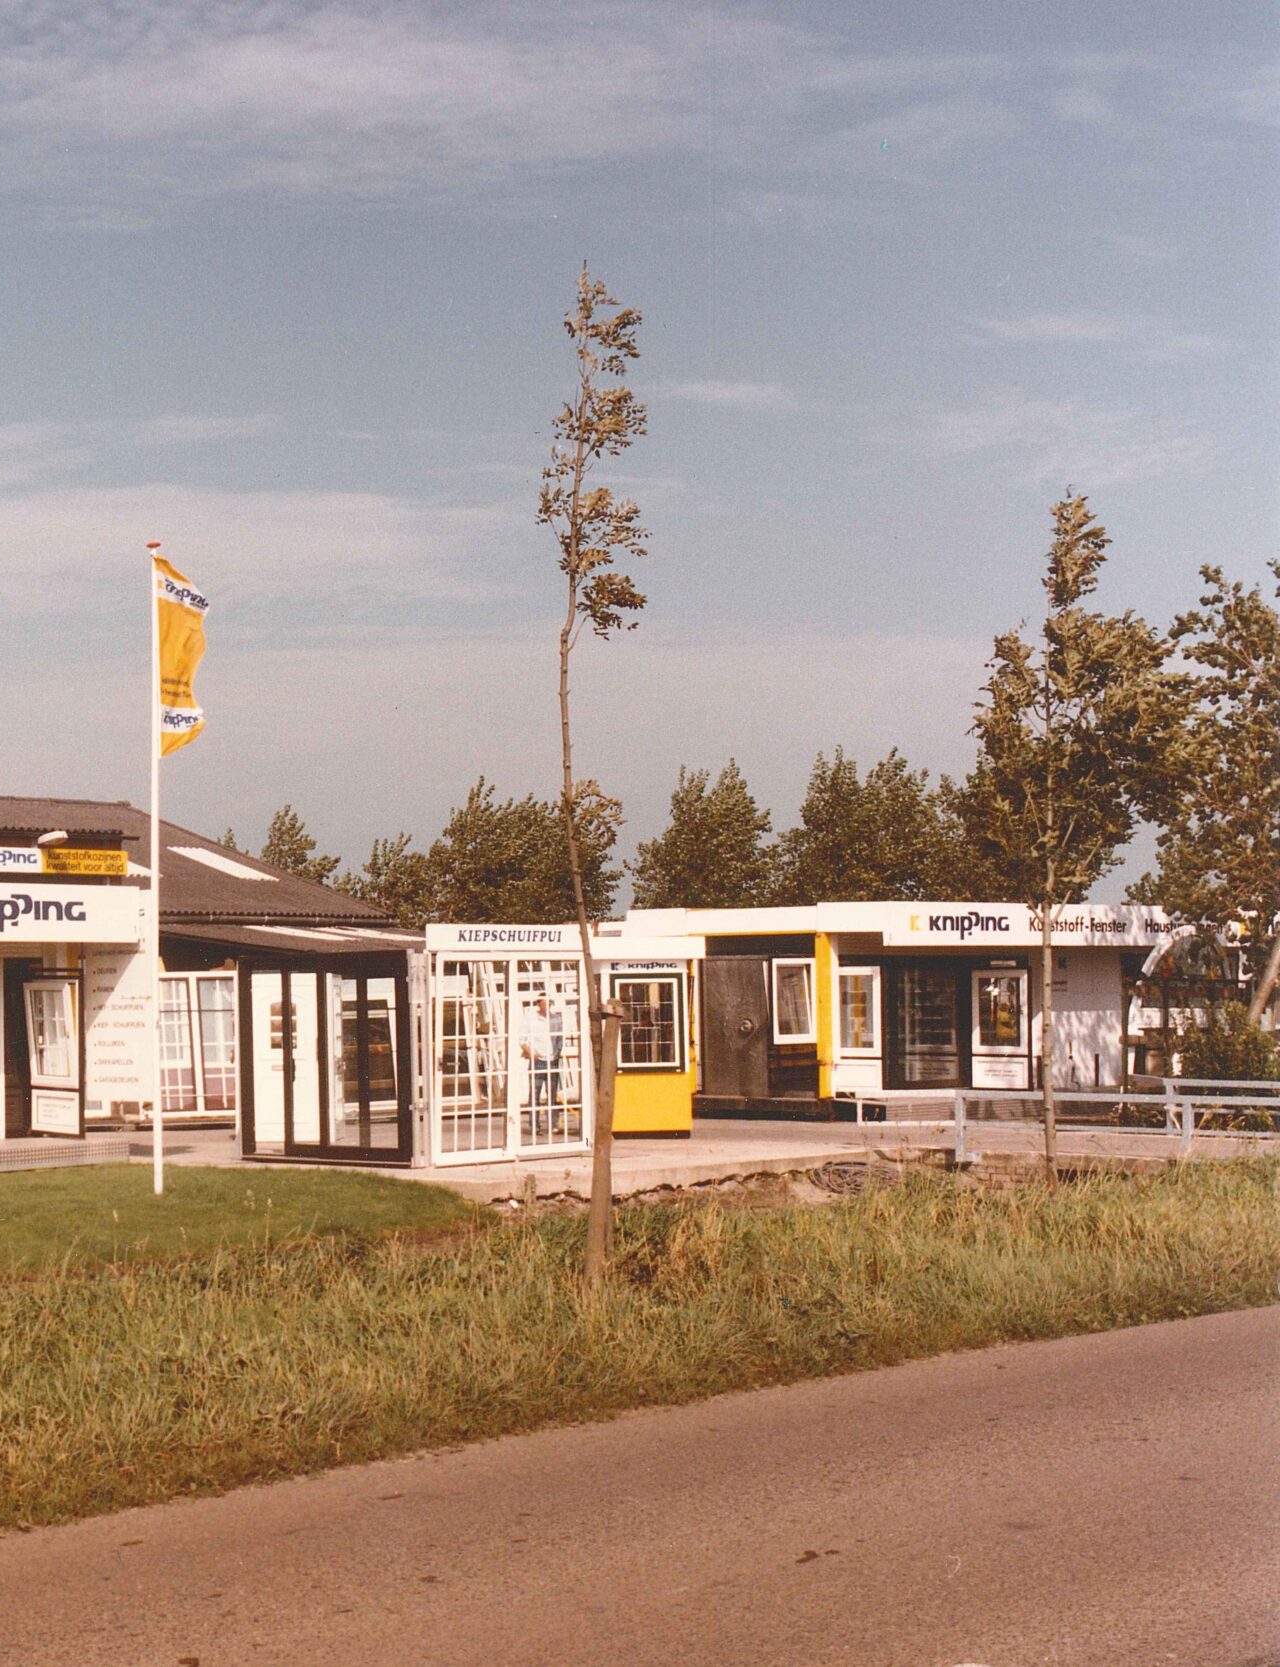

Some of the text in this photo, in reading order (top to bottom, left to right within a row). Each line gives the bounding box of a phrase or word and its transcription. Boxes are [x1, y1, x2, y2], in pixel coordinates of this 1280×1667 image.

[83, 863, 102, 872] voor
[1029, 916, 1127, 933] Kuststoff-Fenster
[458, 929, 562, 943] KIEPSCHUIFPUI
